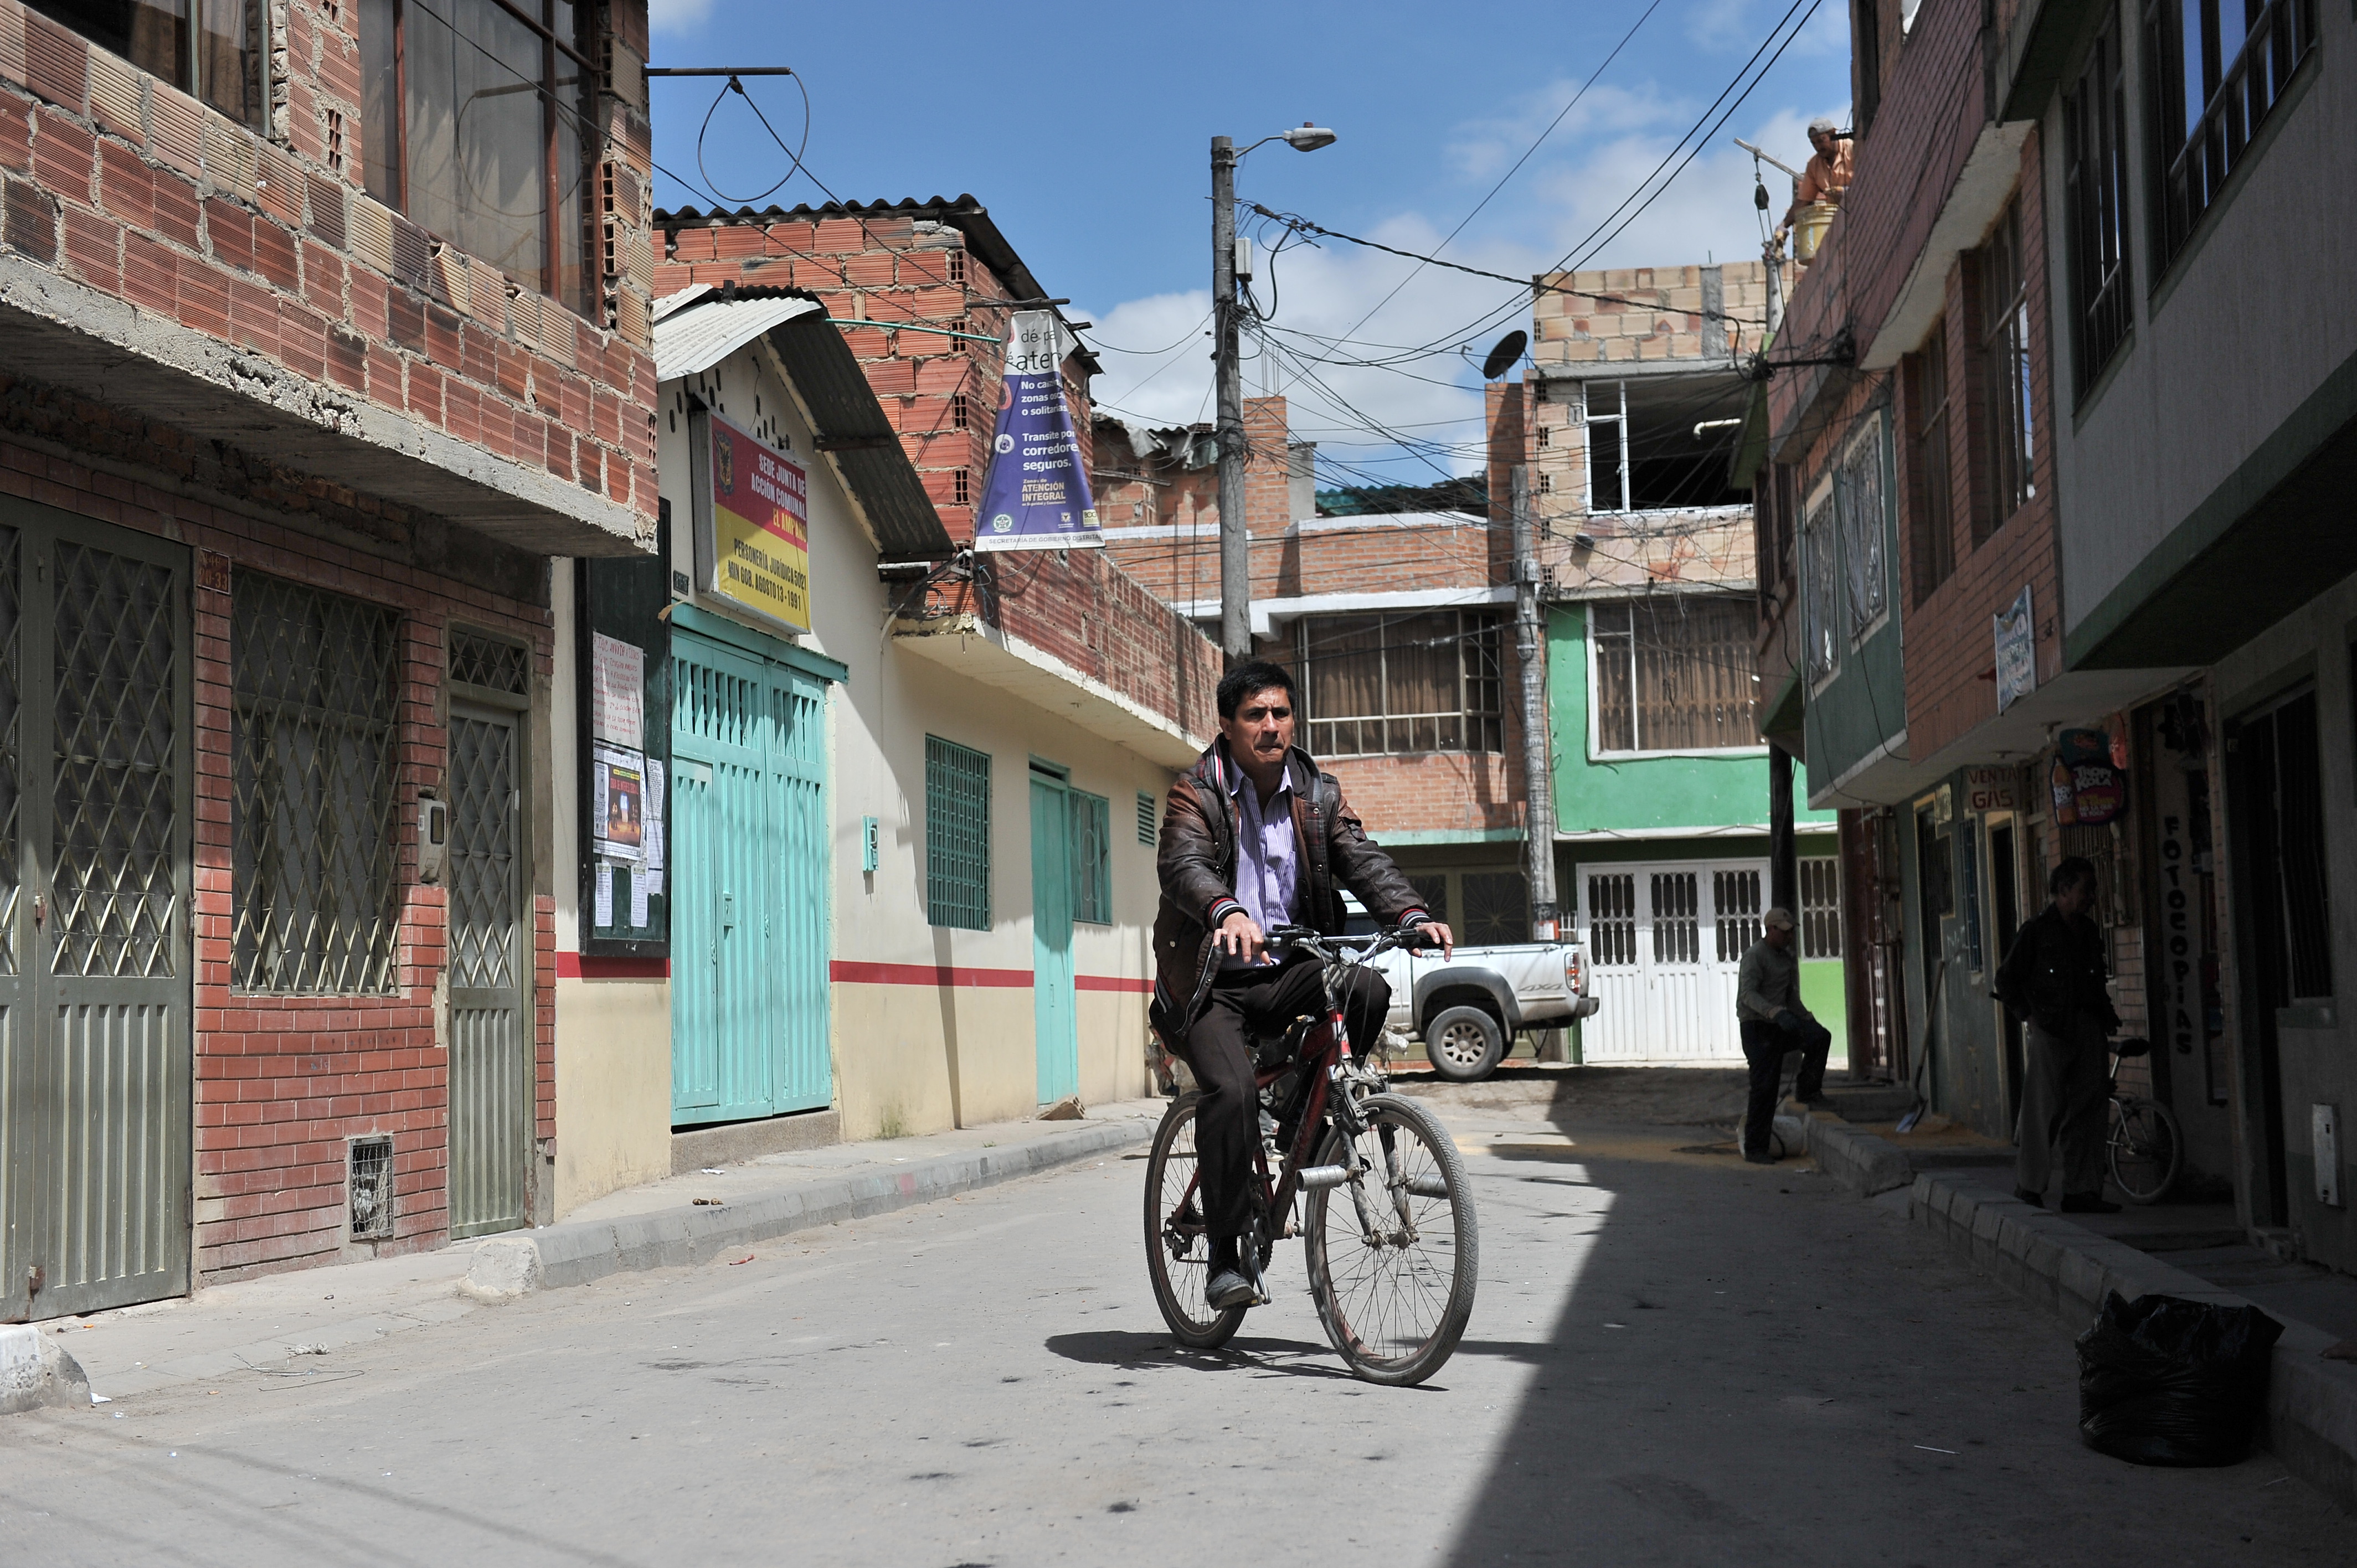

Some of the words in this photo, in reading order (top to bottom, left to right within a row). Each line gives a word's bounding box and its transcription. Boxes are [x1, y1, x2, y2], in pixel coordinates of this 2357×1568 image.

[1021, 329, 1038, 343] dé
[1021, 381, 1035, 390] No
[1021, 394, 1048, 403] zonas
[1022, 431, 1059, 442] Transite
[1022, 442, 1079, 456] corredore
[1023, 459, 1072, 472] seguros.
[759, 453, 775, 479] SEDE
[776, 465, 796, 492] JUNTA
[798, 477, 805, 498] DE
[1022, 481, 1064, 493] ATENCIÓN
[751, 472, 775, 502] ACCIÓN
[776, 487, 806, 522] COMUNAL
[1022, 491, 1066, 502] INTEGRAL
[773, 508, 780, 528] EL
[781, 512, 807, 543] AMPARO
[1073, 533, 1102, 541] DISTRITAL
[734, 538, 768, 572] PERSONERÍA
[770, 558, 794, 585] JURÍDICA
[794, 570, 806, 591] 5021
[728, 560, 739, 582] MIN
[740, 566, 754, 589] GOB.
[755, 573, 776, 600] AGOSTO
[776, 584, 784, 603] 13
[788, 589, 801, 611] 1991
[1969, 768, 2017, 784] VENTA
[1972, 790, 2014, 809] GAS
